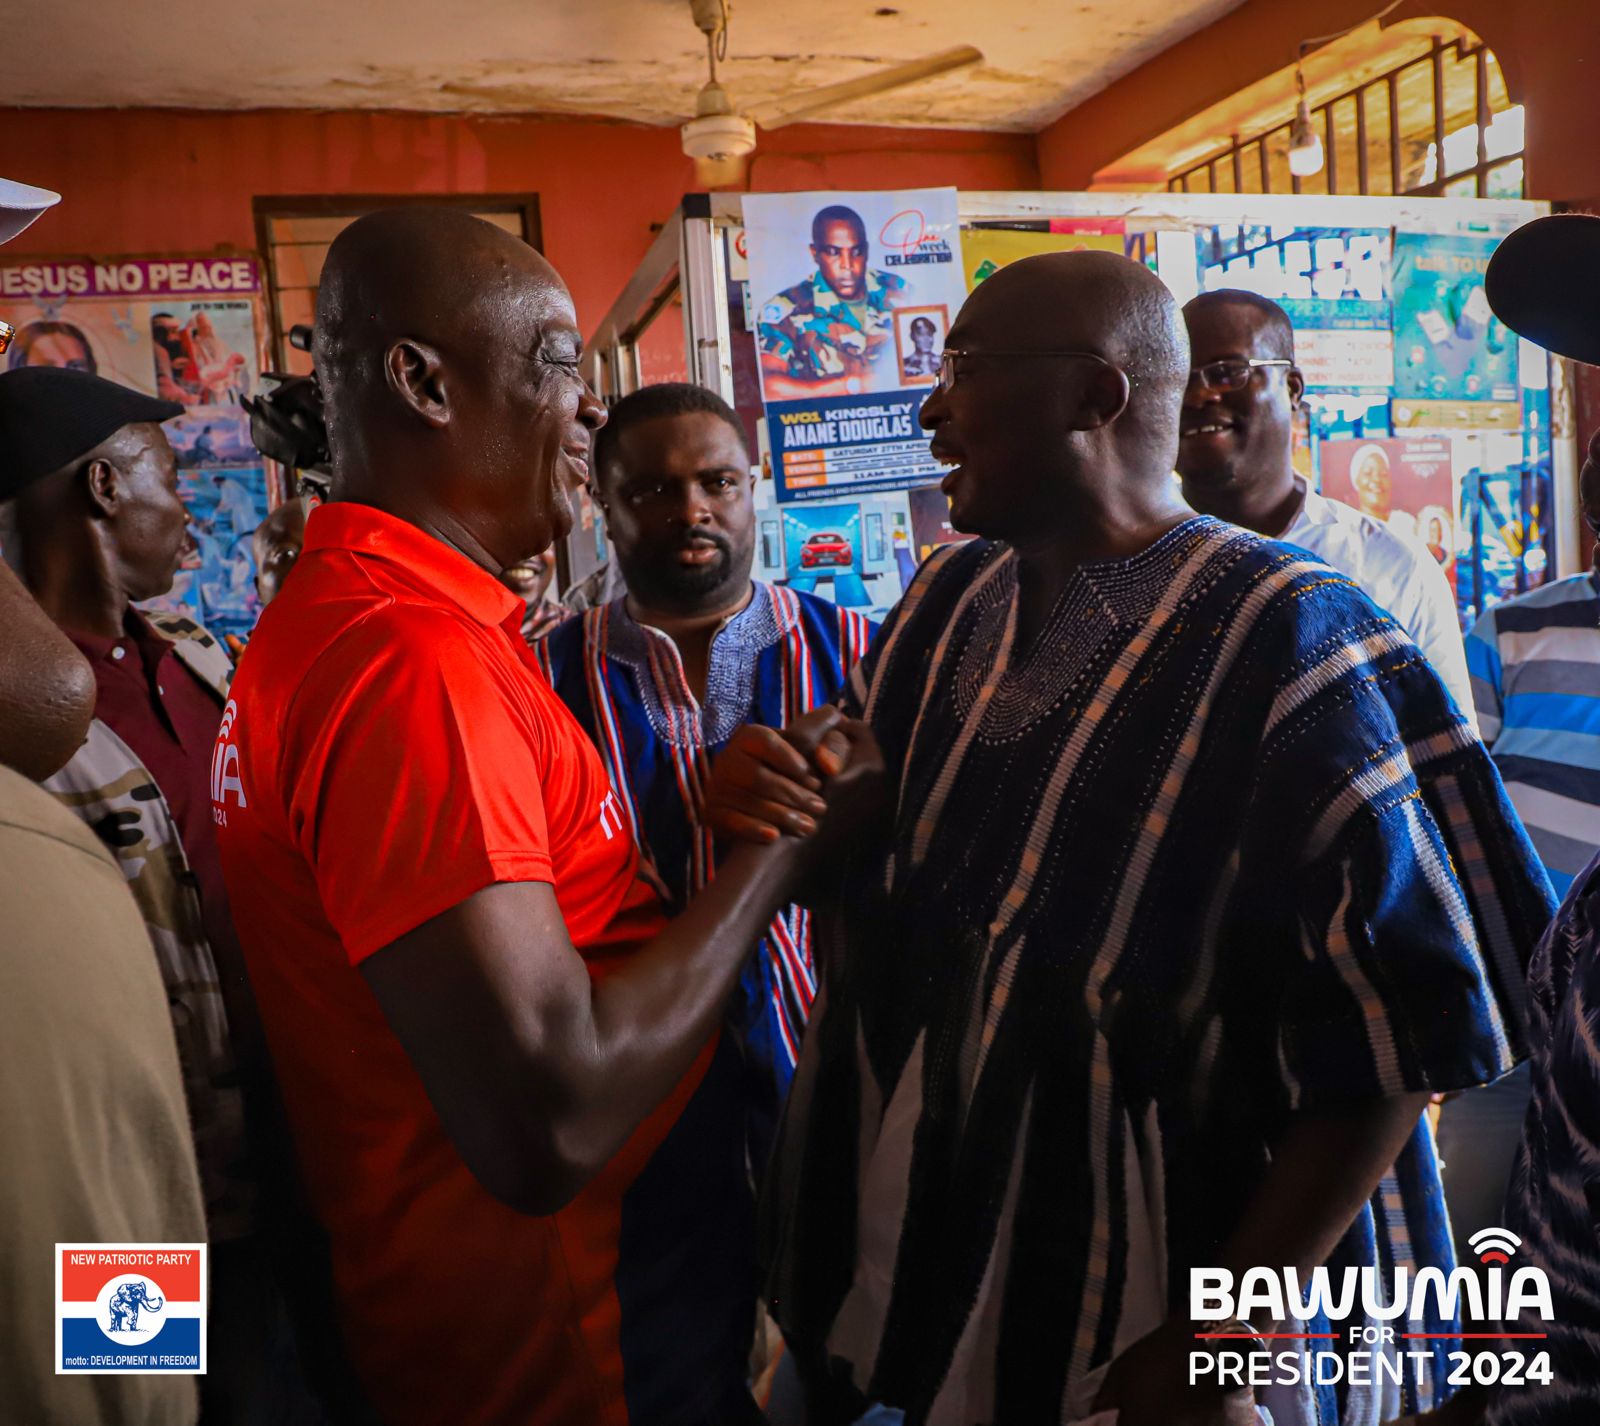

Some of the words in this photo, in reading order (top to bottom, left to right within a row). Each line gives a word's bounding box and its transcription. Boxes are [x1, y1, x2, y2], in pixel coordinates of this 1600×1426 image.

[0, 265, 89, 295] ESUS
[95, 263, 144, 292] NO
[148, 261, 253, 291] PEACE
[825, 403, 913, 421] KINGSLEY
[784, 422, 838, 448] ANANE
[840, 415, 912, 443] DOUGLAS
[833, 446, 879, 457] SATURDAY
[918, 464, 937, 474] PM
